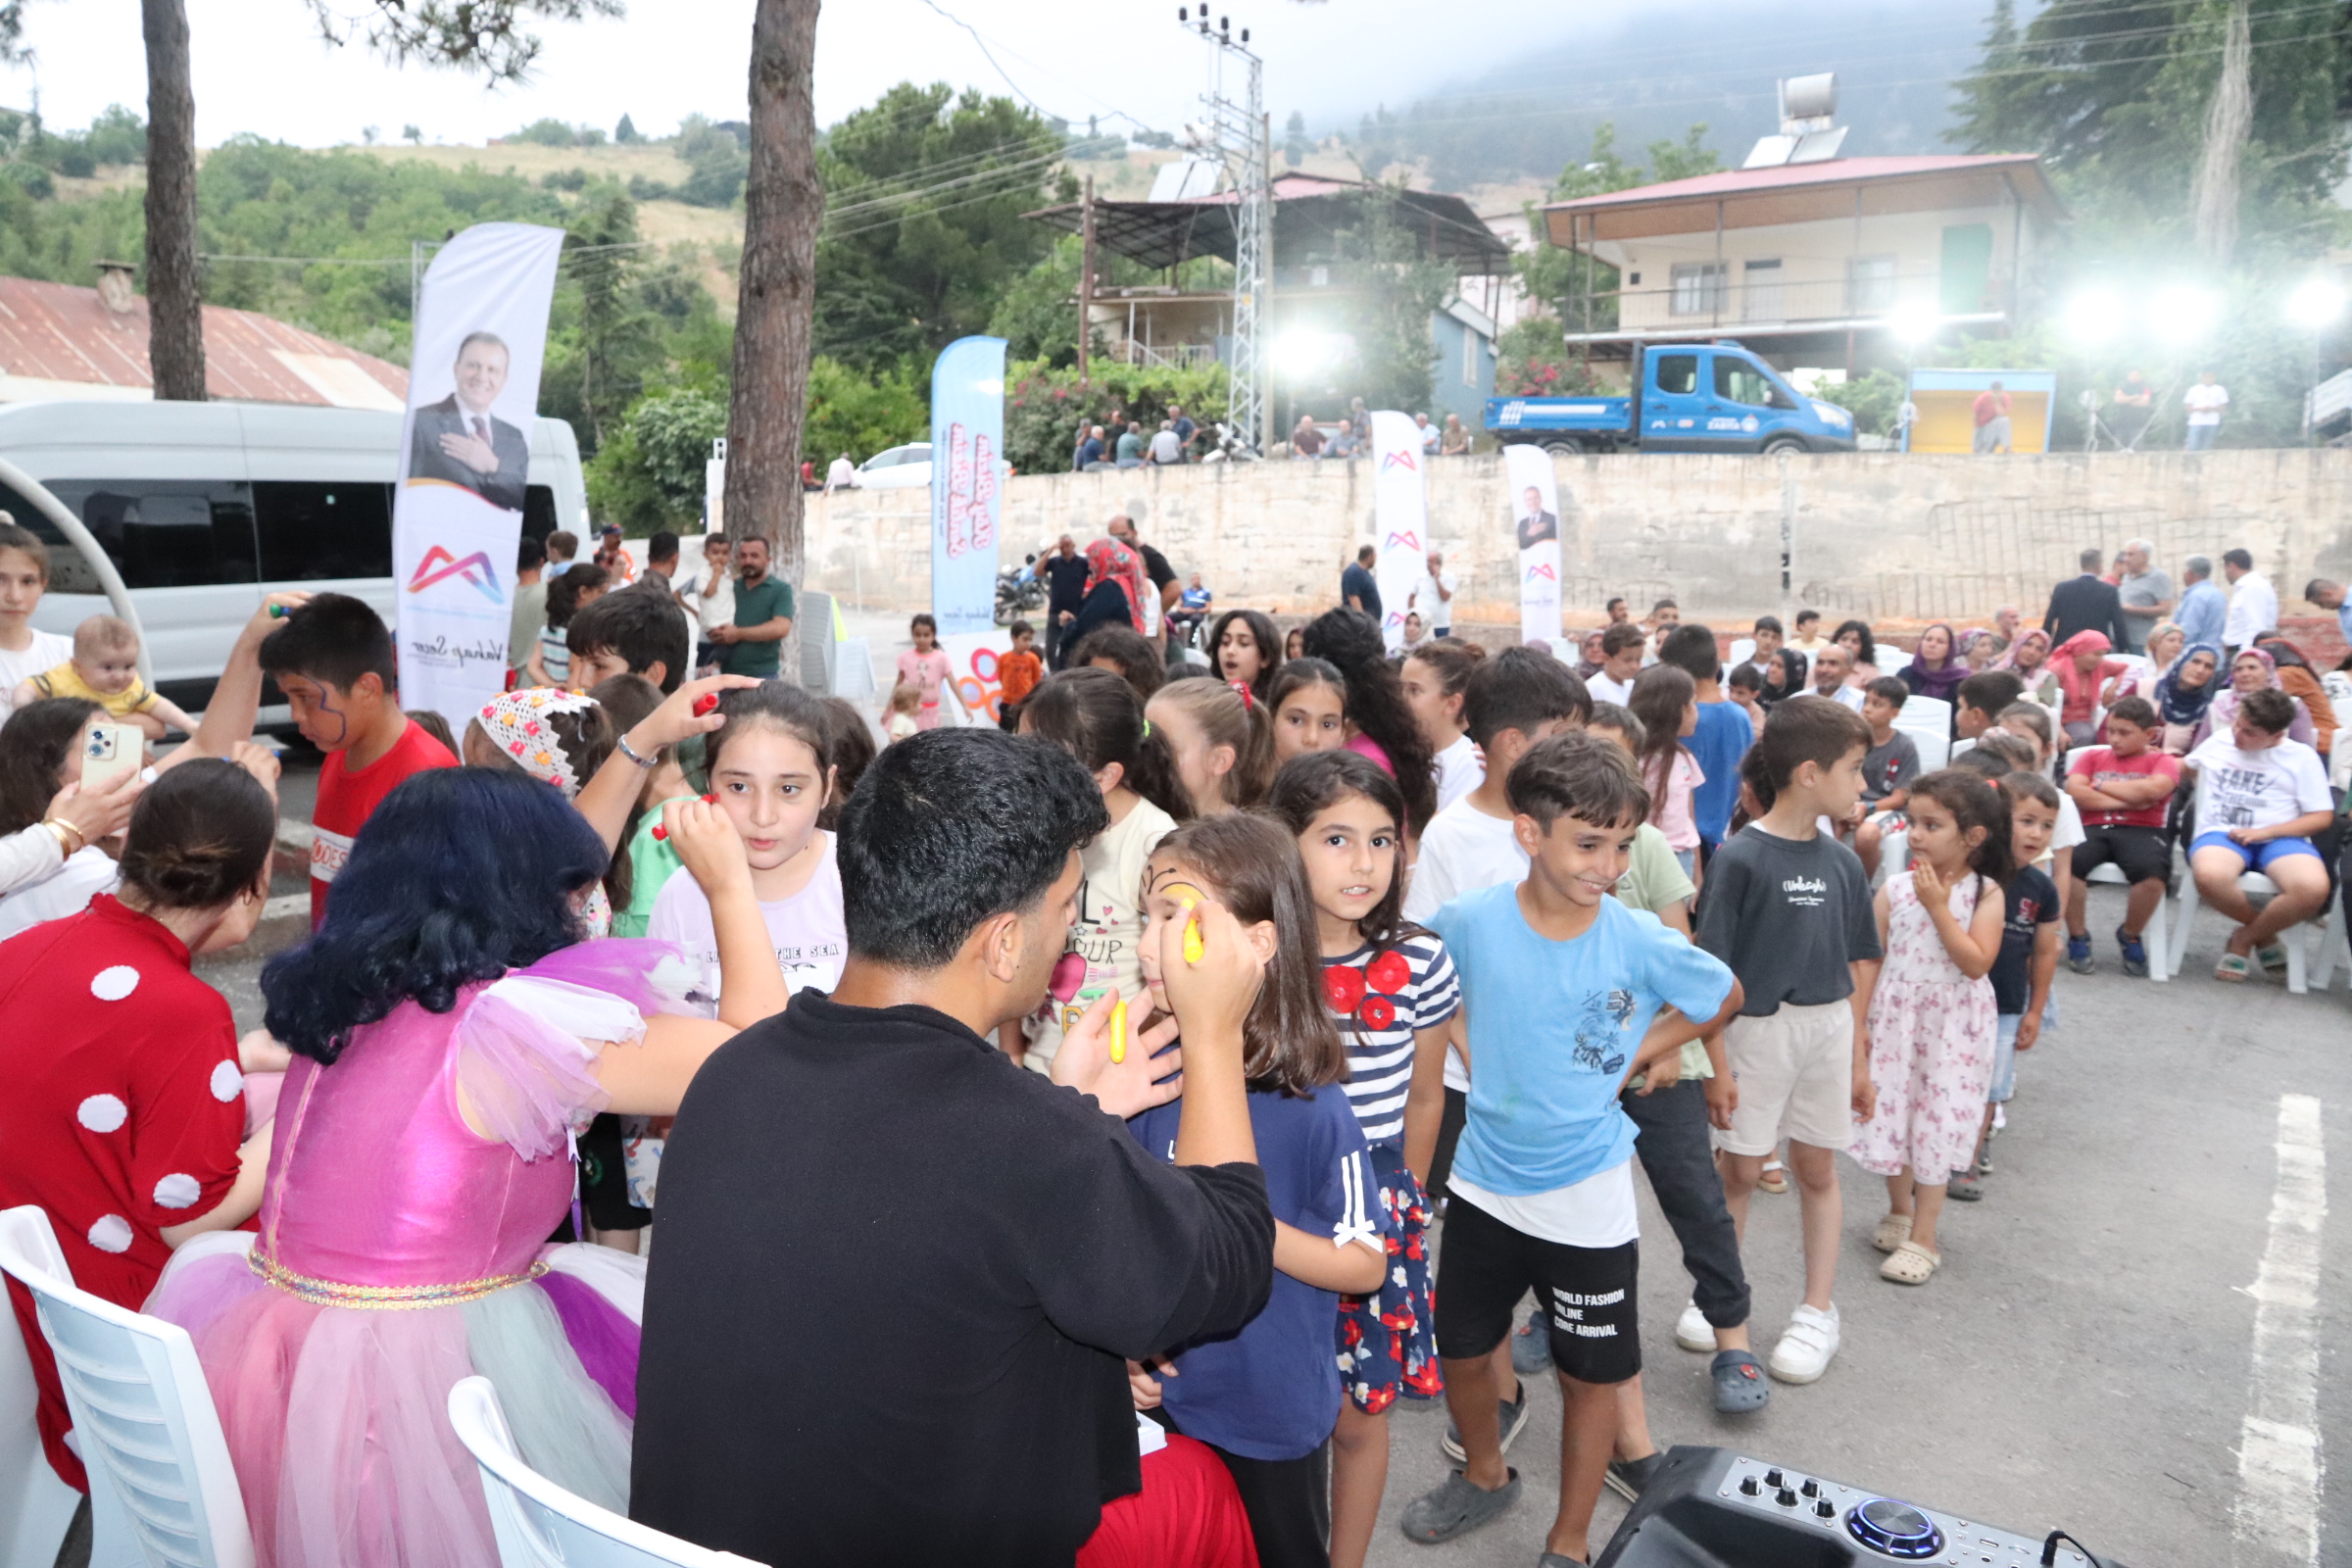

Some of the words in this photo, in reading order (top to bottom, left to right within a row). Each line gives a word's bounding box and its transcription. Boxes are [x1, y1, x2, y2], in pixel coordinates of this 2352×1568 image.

[775, 947, 802, 959] THE
[810, 944, 840, 957] SEA
[1066, 936, 1122, 964] OUR
[1584, 1288, 1625, 1306] FASHION
[1576, 1323, 1619, 1338] ARRIVAL
